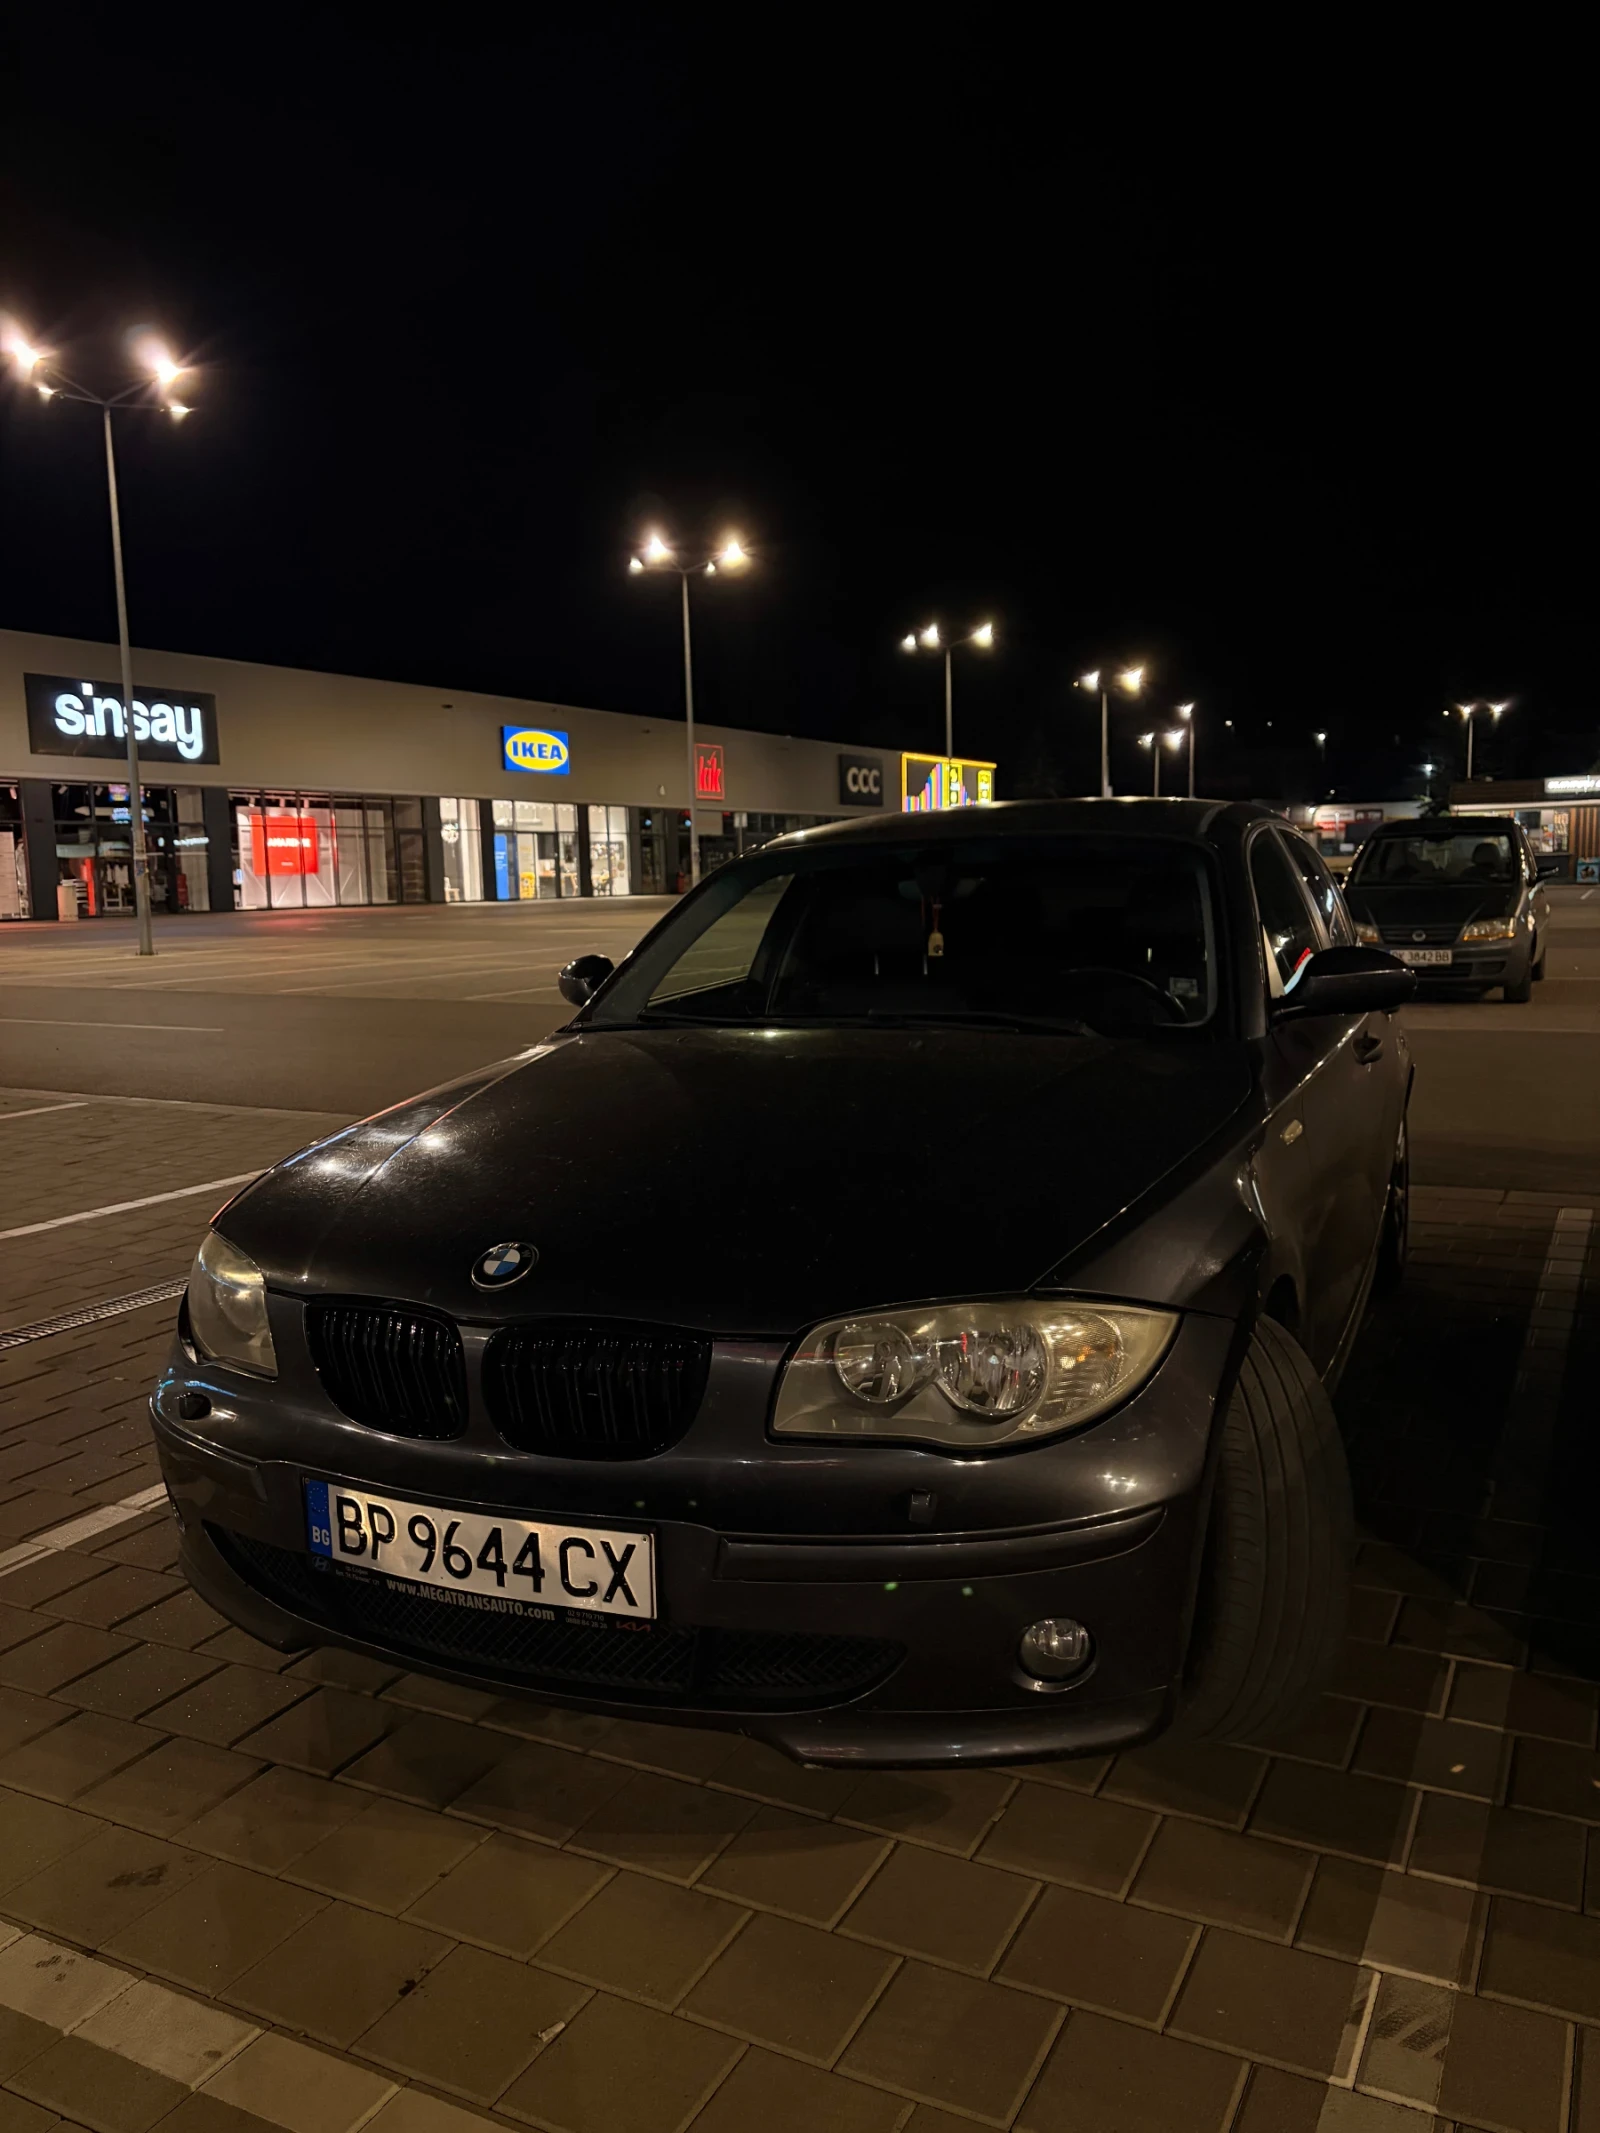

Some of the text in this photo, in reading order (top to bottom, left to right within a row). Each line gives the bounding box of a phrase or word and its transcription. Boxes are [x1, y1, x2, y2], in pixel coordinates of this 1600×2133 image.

[54, 682, 204, 760] sinsay
[512, 740, 563, 761] IKEA
[847, 766, 880, 794] CCC
[1408, 951, 1434, 962] 3842
[312, 1525, 331, 1547] BG
[336, 1494, 639, 1607] BP 9644 CX
[386, 1579, 556, 1621] www.MEGATRANSAUTO.com
